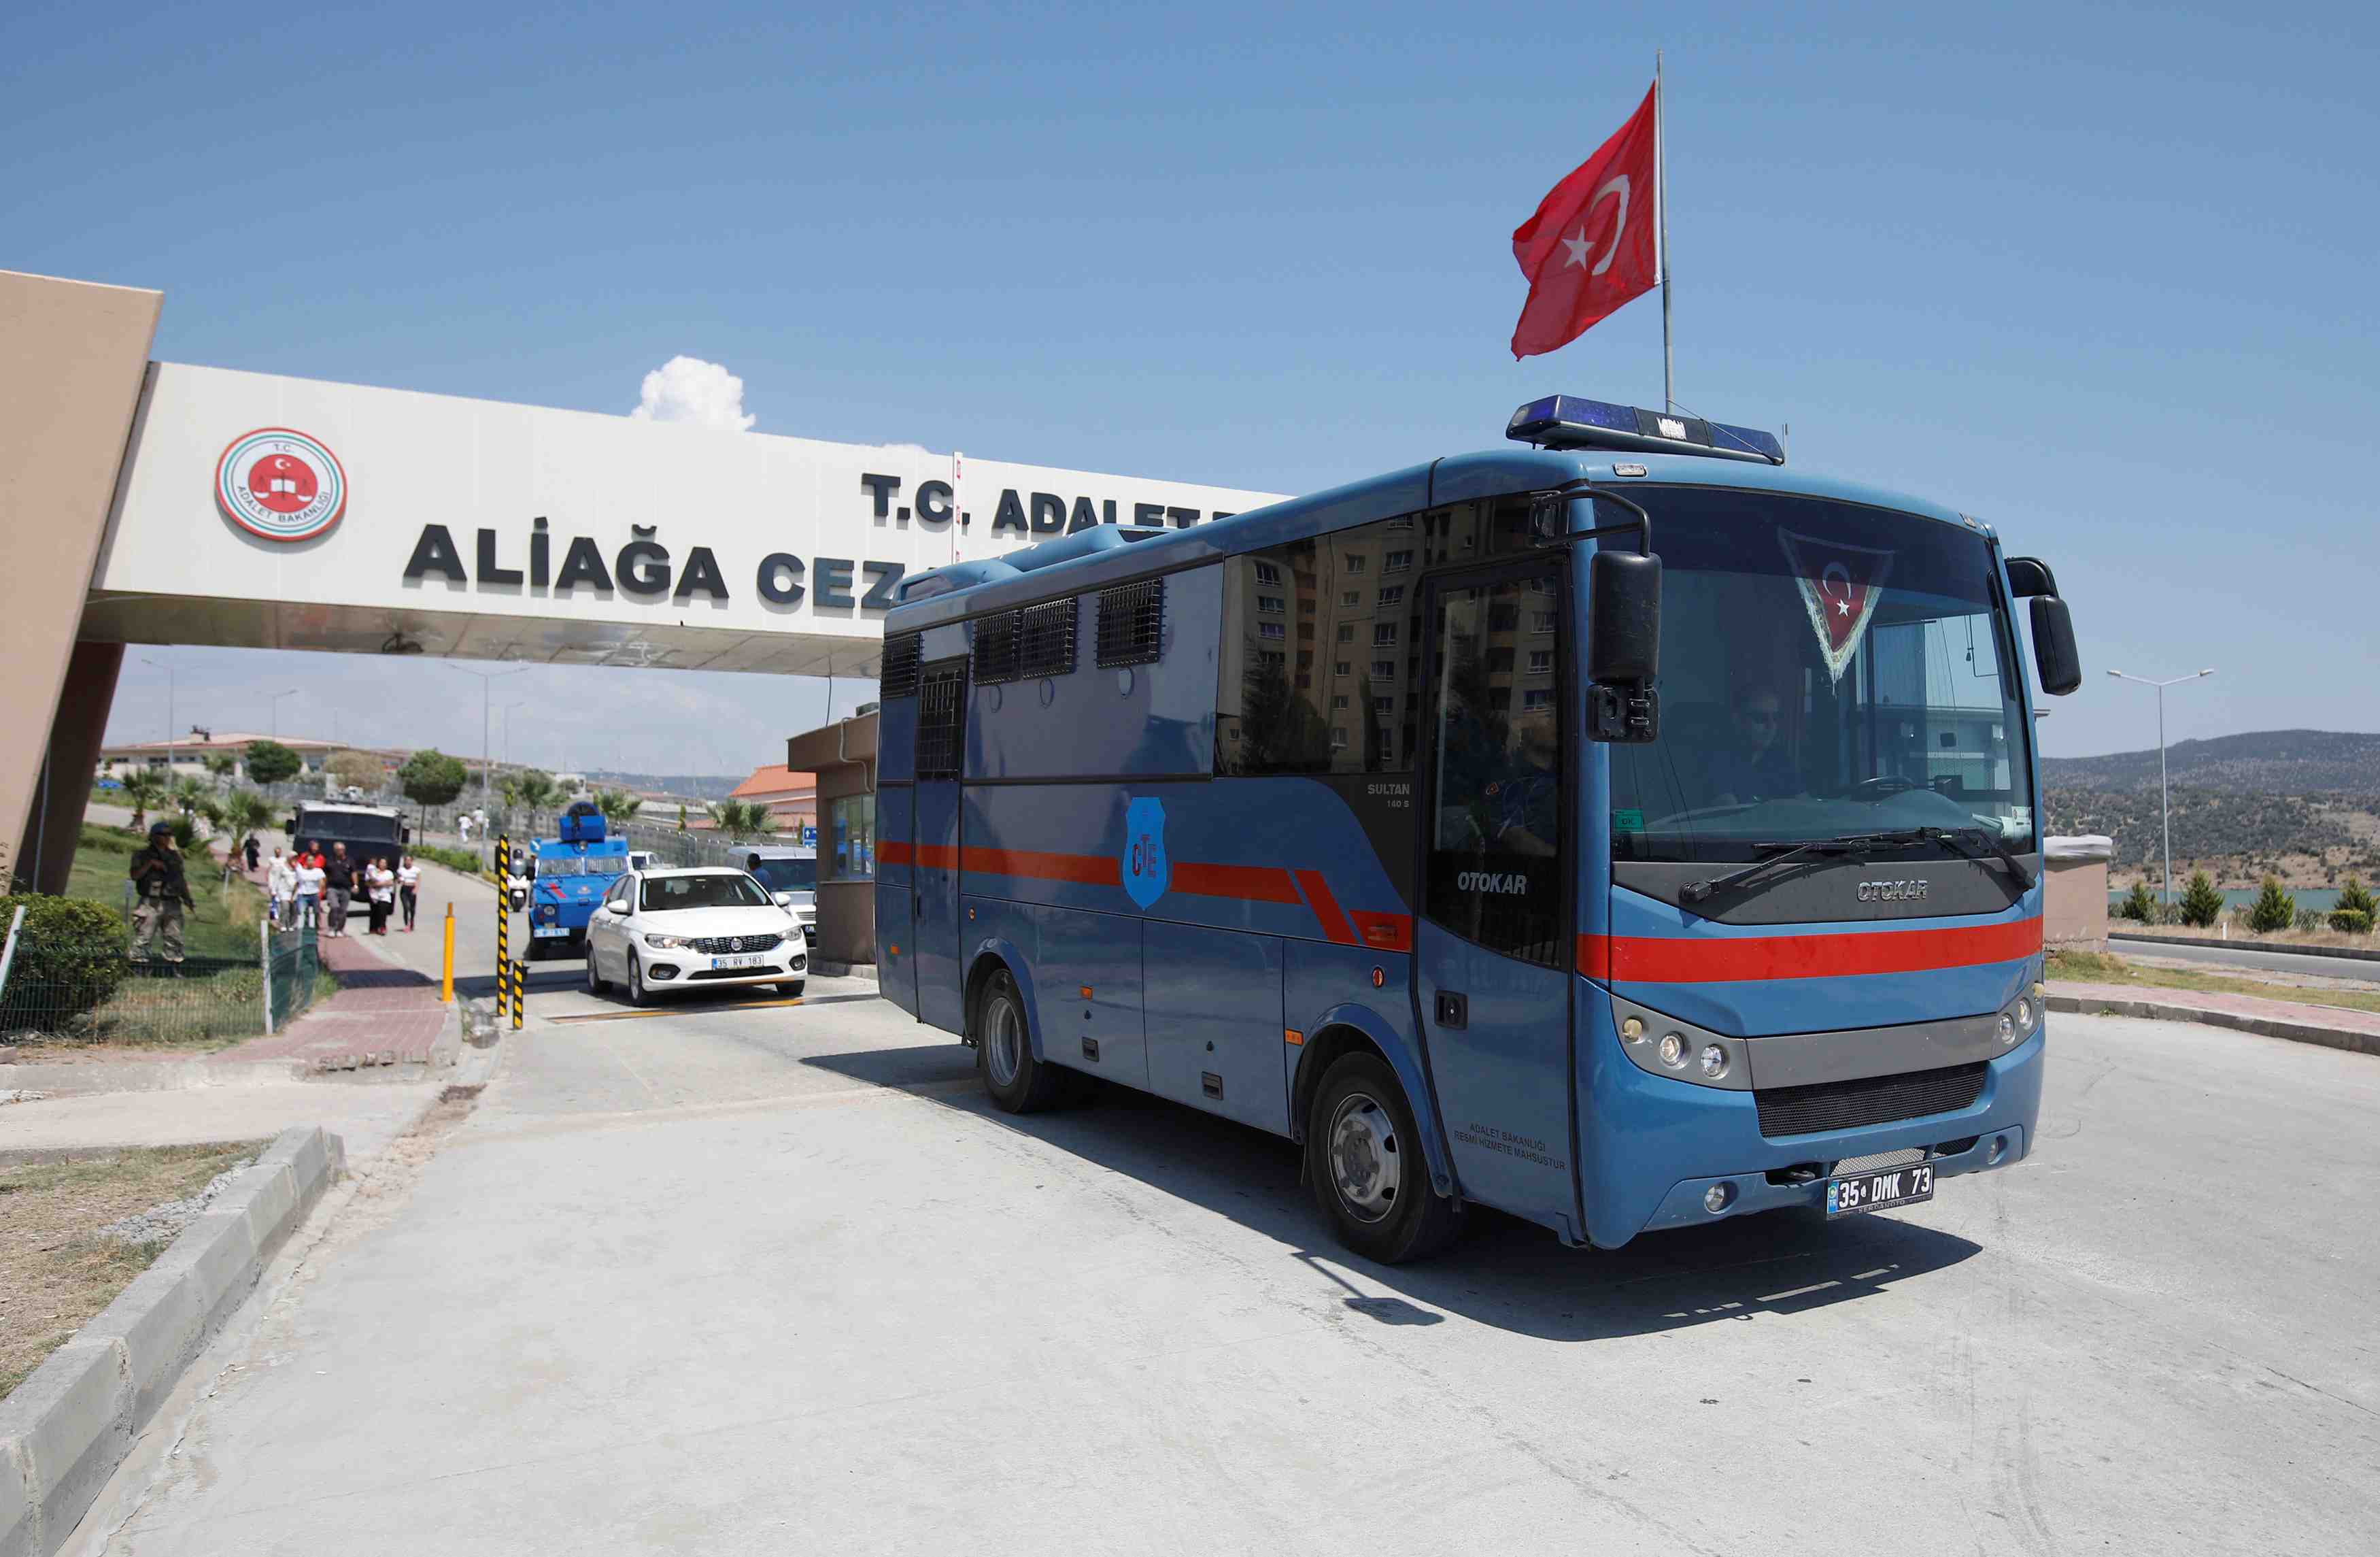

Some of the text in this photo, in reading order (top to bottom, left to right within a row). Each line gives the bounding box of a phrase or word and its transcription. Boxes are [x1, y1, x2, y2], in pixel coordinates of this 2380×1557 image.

[237, 485, 272, 519] ADALET
[861, 472, 971, 526] T.C.
[403, 516, 936, 610] ALİAĞA CEZ
[1367, 783, 1410, 795] SULTAN
[1457, 871, 1527, 895] OTOKAR
[1856, 880, 1928, 902] OTOKAR
[1469, 1122, 1500, 1139] ADALET
[1839, 1167, 1931, 1208] 35 DMK 73
